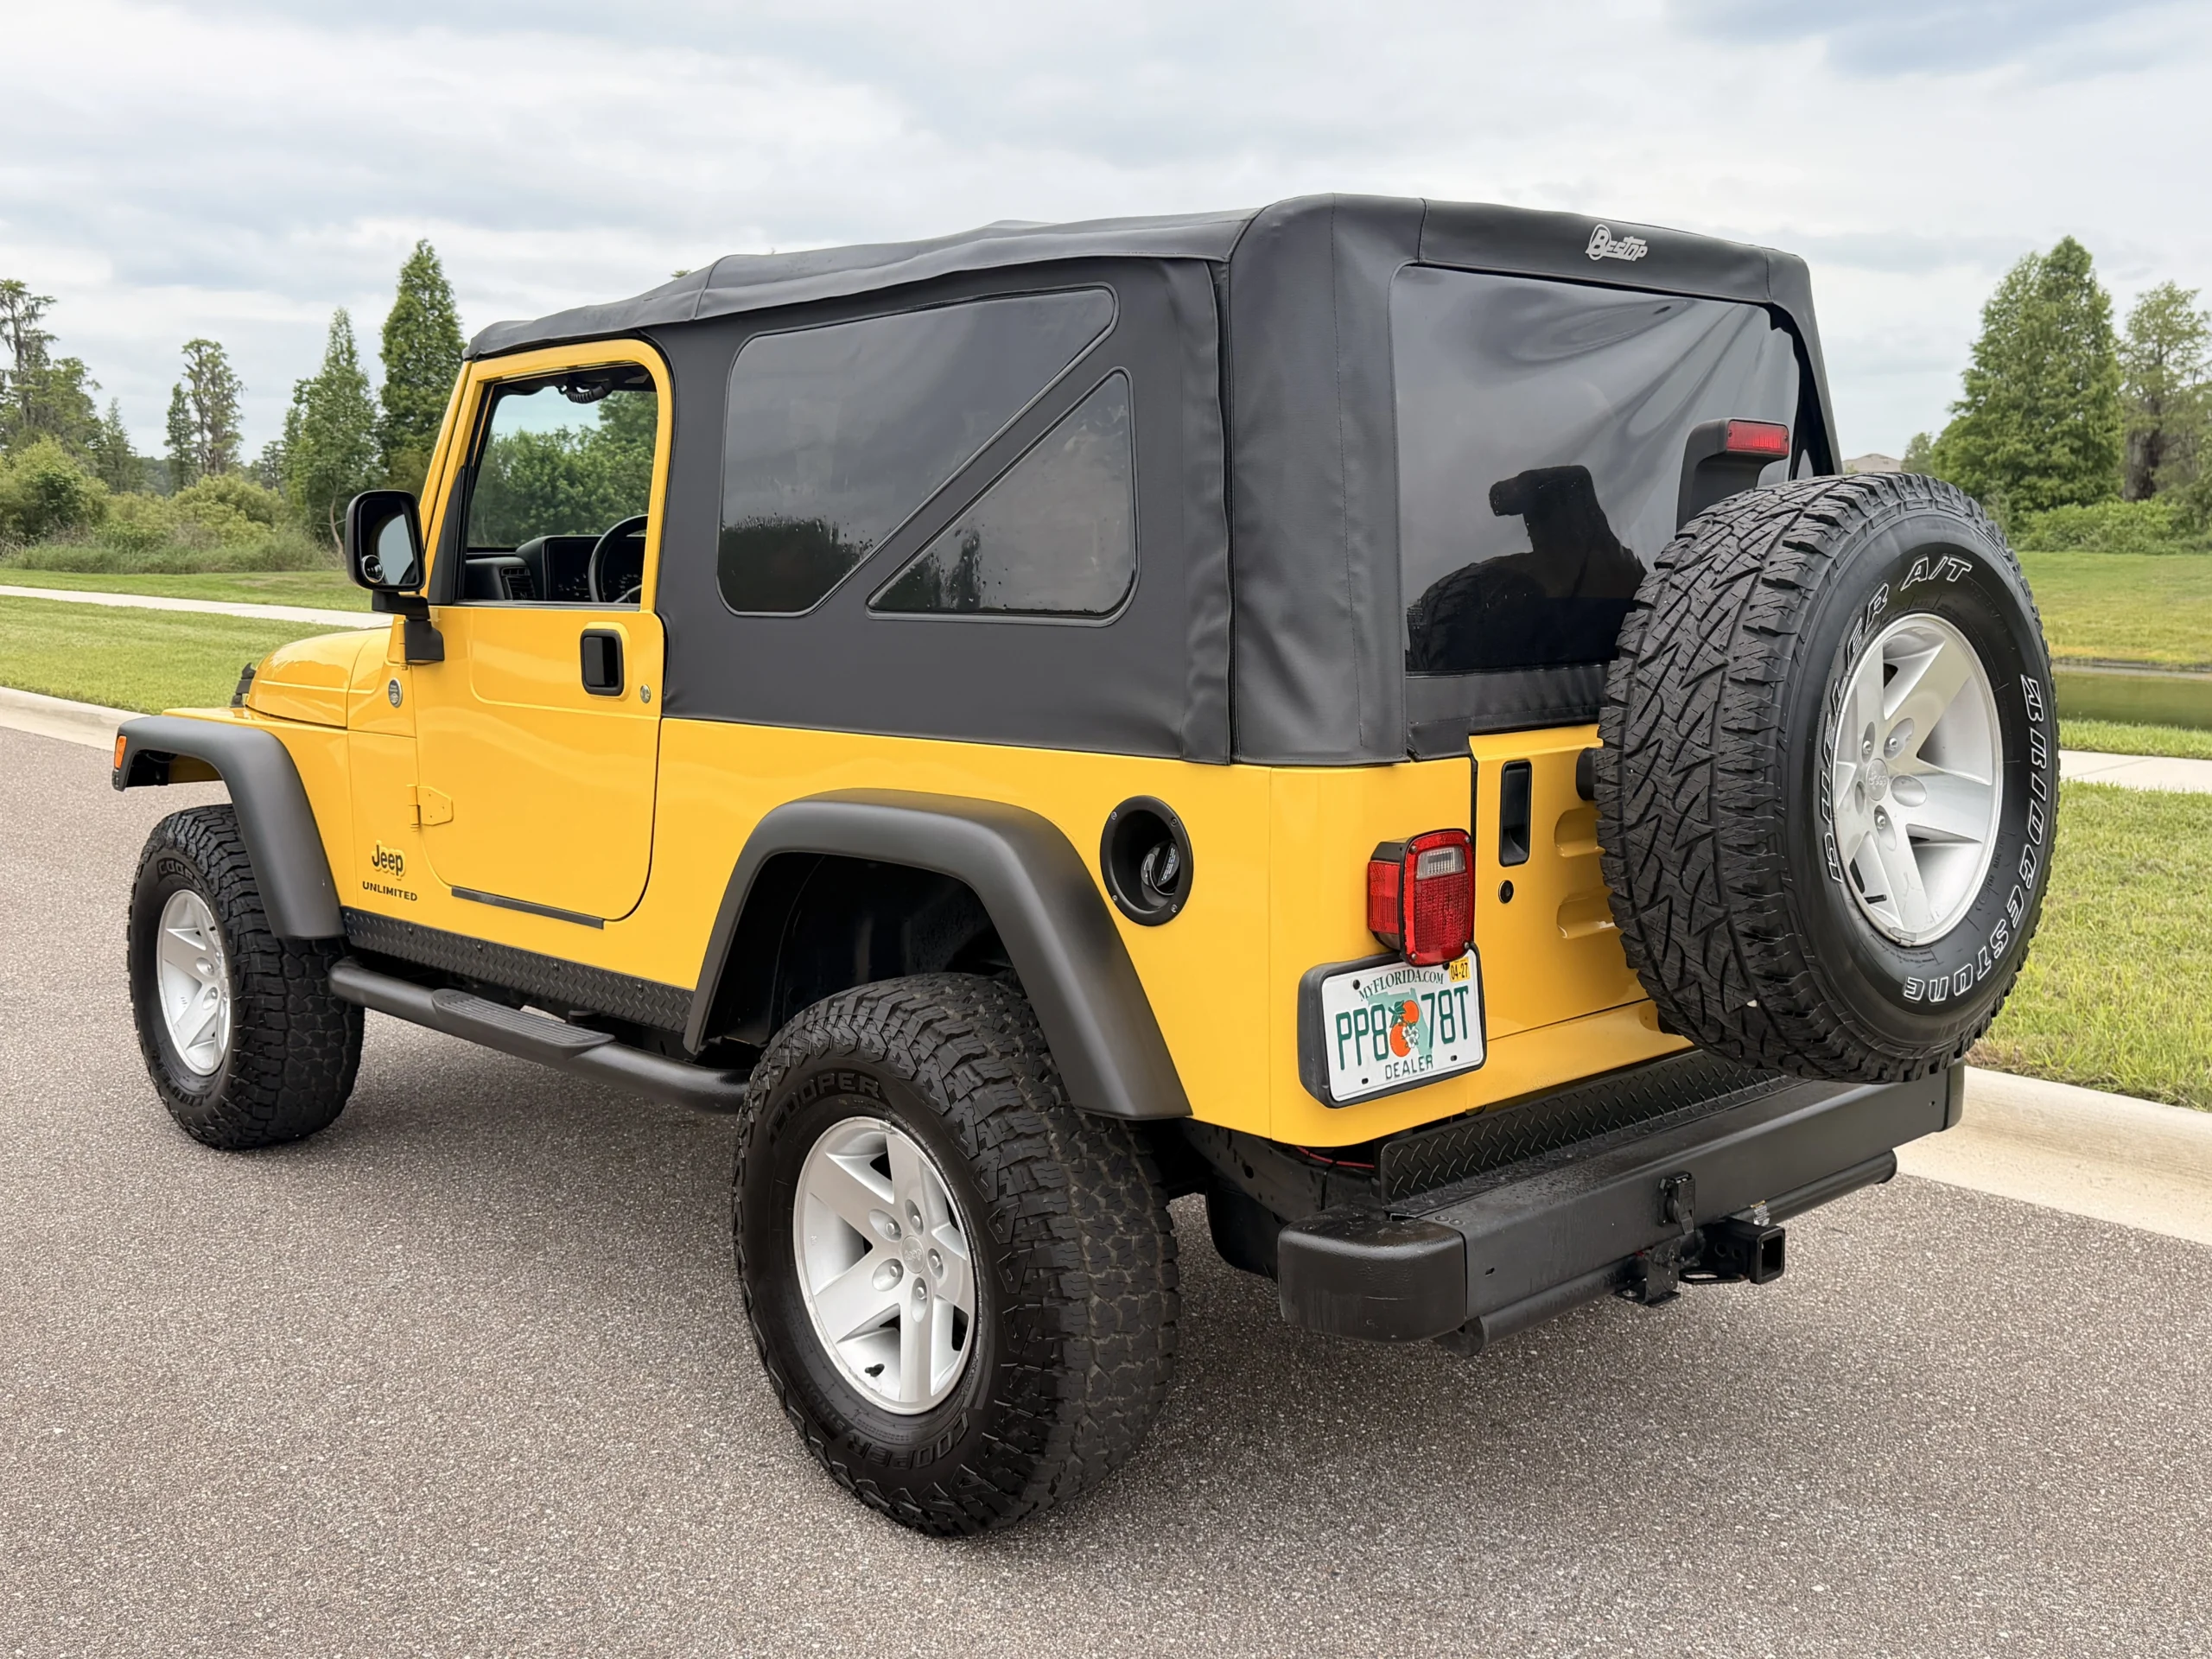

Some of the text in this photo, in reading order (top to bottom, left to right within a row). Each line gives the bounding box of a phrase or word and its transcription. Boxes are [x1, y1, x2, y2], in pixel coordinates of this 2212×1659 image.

[1900, 556, 1973, 592] A/T
[372, 843, 404, 877] Jeep
[362, 880, 418, 902] UNLIMITED
[1358, 969, 1445, 1002] MYFLORIDA.COM
[1384, 1053, 1434, 1081] DEALER
[766, 1071, 880, 1139] COOPER
